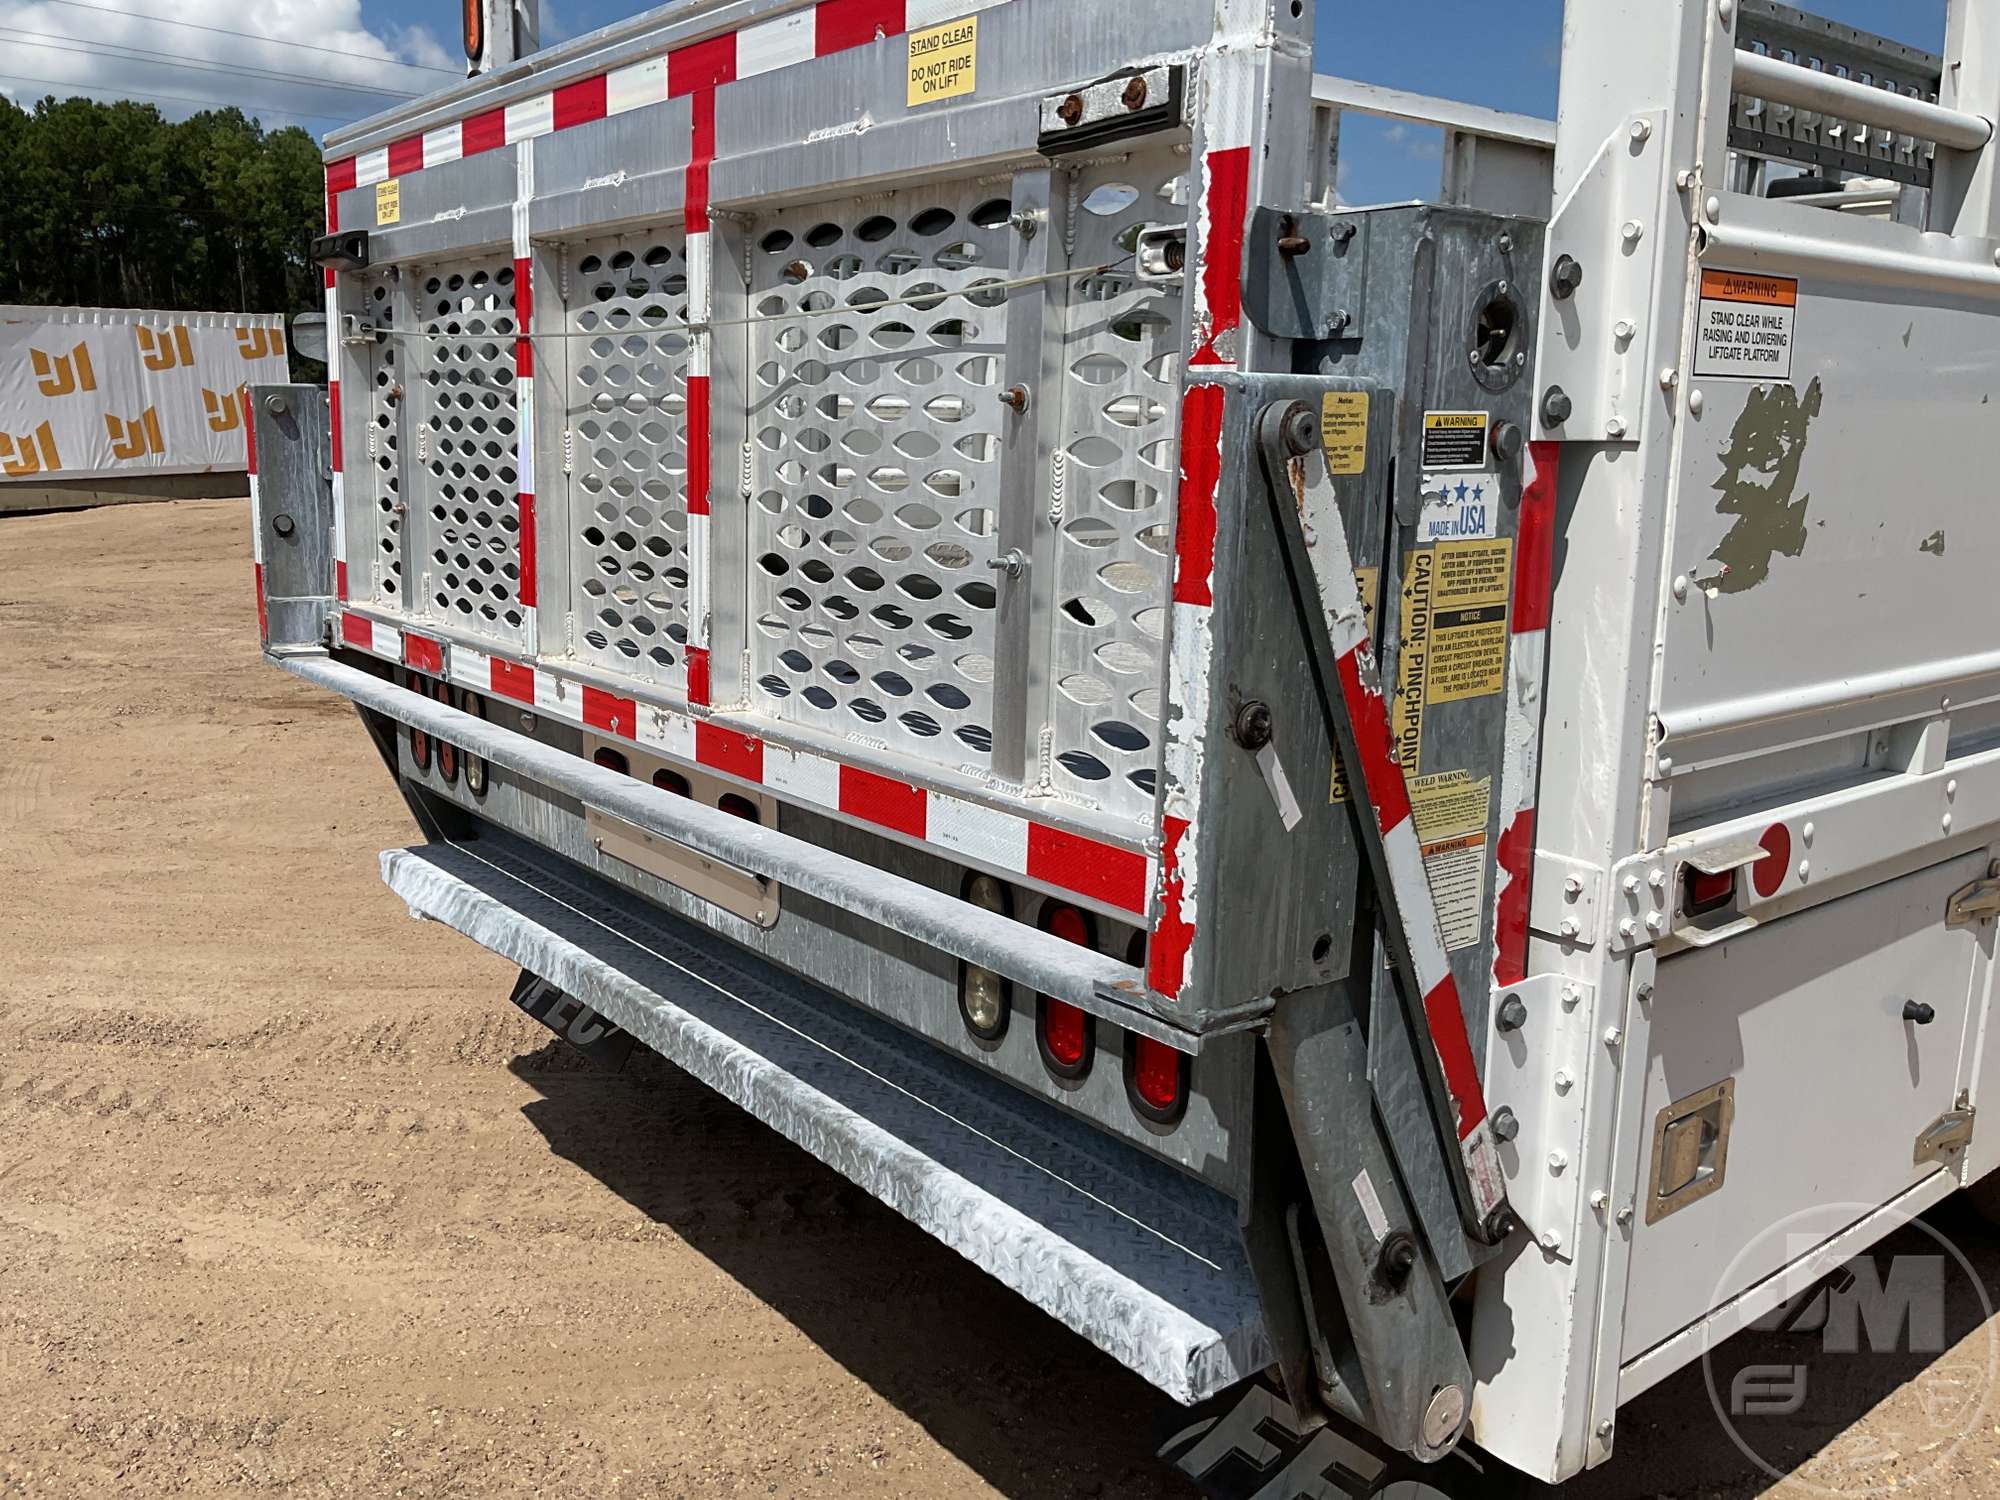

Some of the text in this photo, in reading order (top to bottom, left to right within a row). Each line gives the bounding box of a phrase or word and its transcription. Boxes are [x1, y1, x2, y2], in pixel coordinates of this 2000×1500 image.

[910, 26, 973, 54] STAND CLEAR
[912, 55, 971, 82] DO NOT RIDE
[923, 74, 958, 93] ON LIFT
[1733, 280, 1777, 298] WARNING
[1711, 312, 1783, 329] STAND CLEAR WHILE
[1703, 329, 1787, 346] RAISING AND LOWERING
[1709, 346, 1779, 362] LIFTGATE PLATFORM
[1443, 417, 1477, 426] WARNING
[1428, 505, 1485, 536] MADE IN USA
[1460, 611, 1480, 622] NOTICE
[1436, 633, 1446, 641] THIS
[1448, 631, 1469, 641] LIFTGATE
[1452, 640, 1479, 650] ELECTRICAL
[1402, 554, 1431, 771] CAUTION: PINCHPOINT
[1434, 654, 1452, 663] CIRCUIT
[1454, 650, 1482, 660] PROTECTION
[1431, 665, 1447, 674] EITHER
[1453, 662, 1472, 671] CIRCUIT
[1414, 777, 1435, 787] WELD
[1438, 772, 1470, 783] WARNING
[1434, 839, 1467, 853] WARNING
